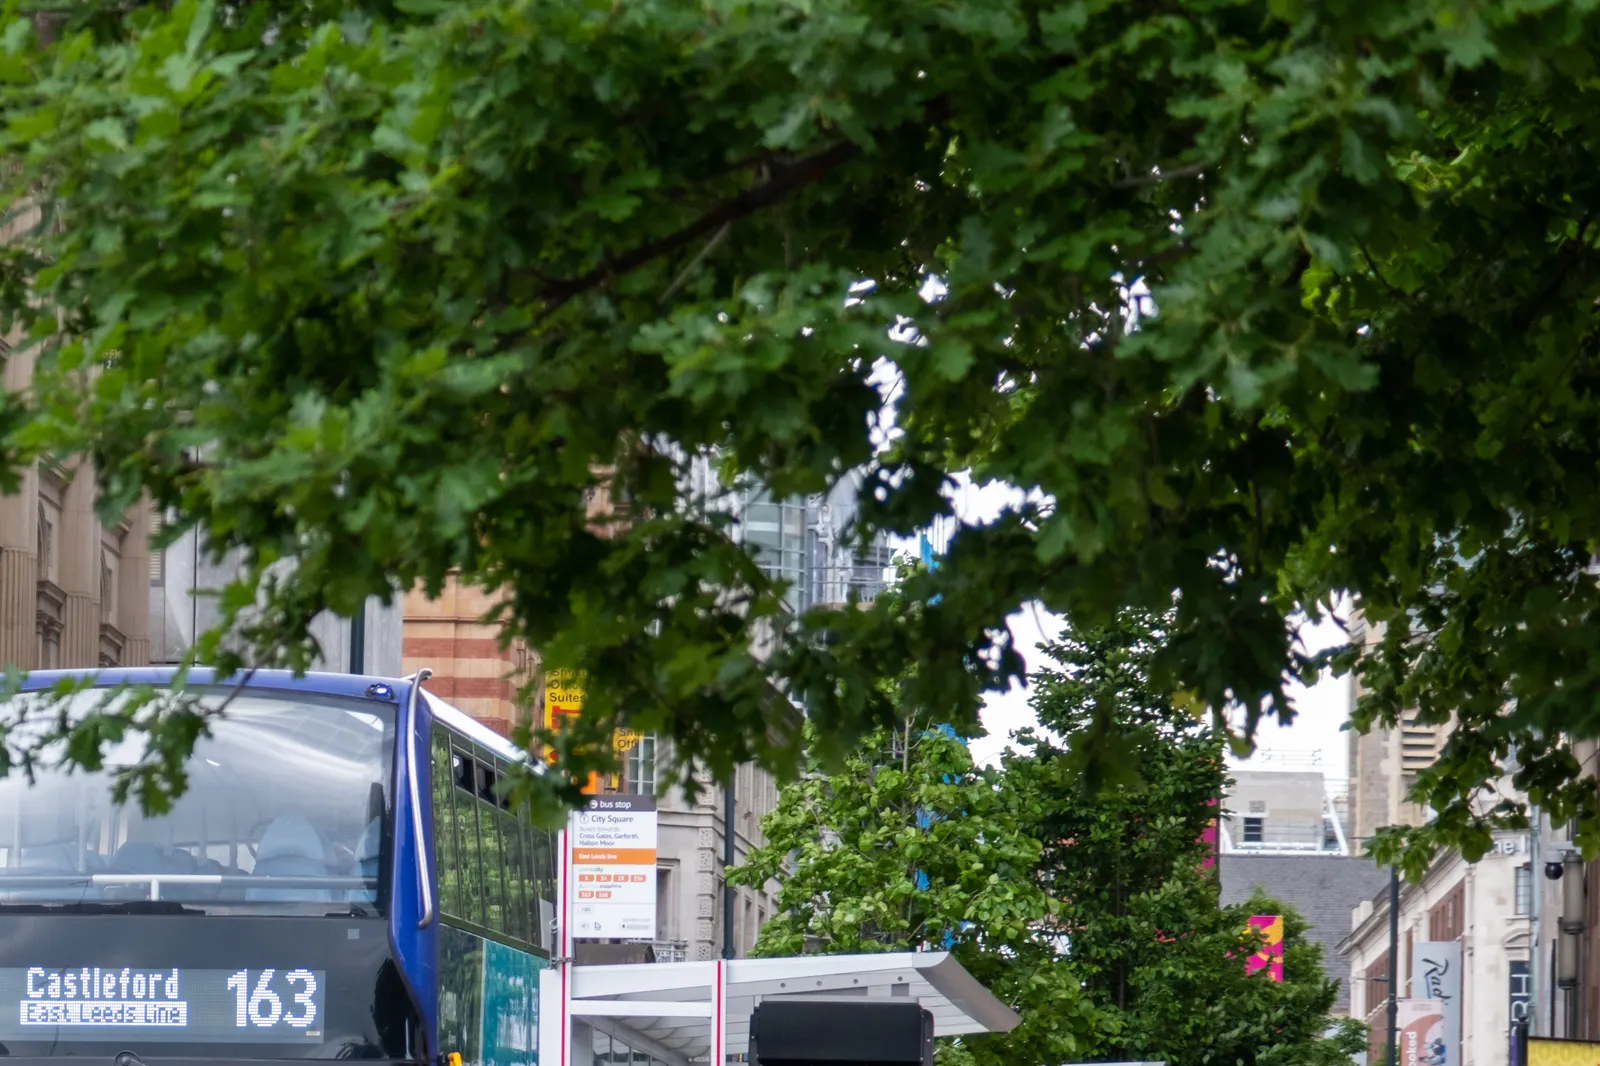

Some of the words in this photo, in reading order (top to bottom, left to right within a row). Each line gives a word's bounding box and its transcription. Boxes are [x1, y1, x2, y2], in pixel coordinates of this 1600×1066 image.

[615, 801, 631, 810] stop
[591, 815, 606, 823] City
[607, 815, 634, 824] Square
[27, 967, 178, 999] Castleford
[227, 968, 317, 1027] 163
[27, 1003, 70, 1023] East
[80, 1003, 135, 1023] Leeds
